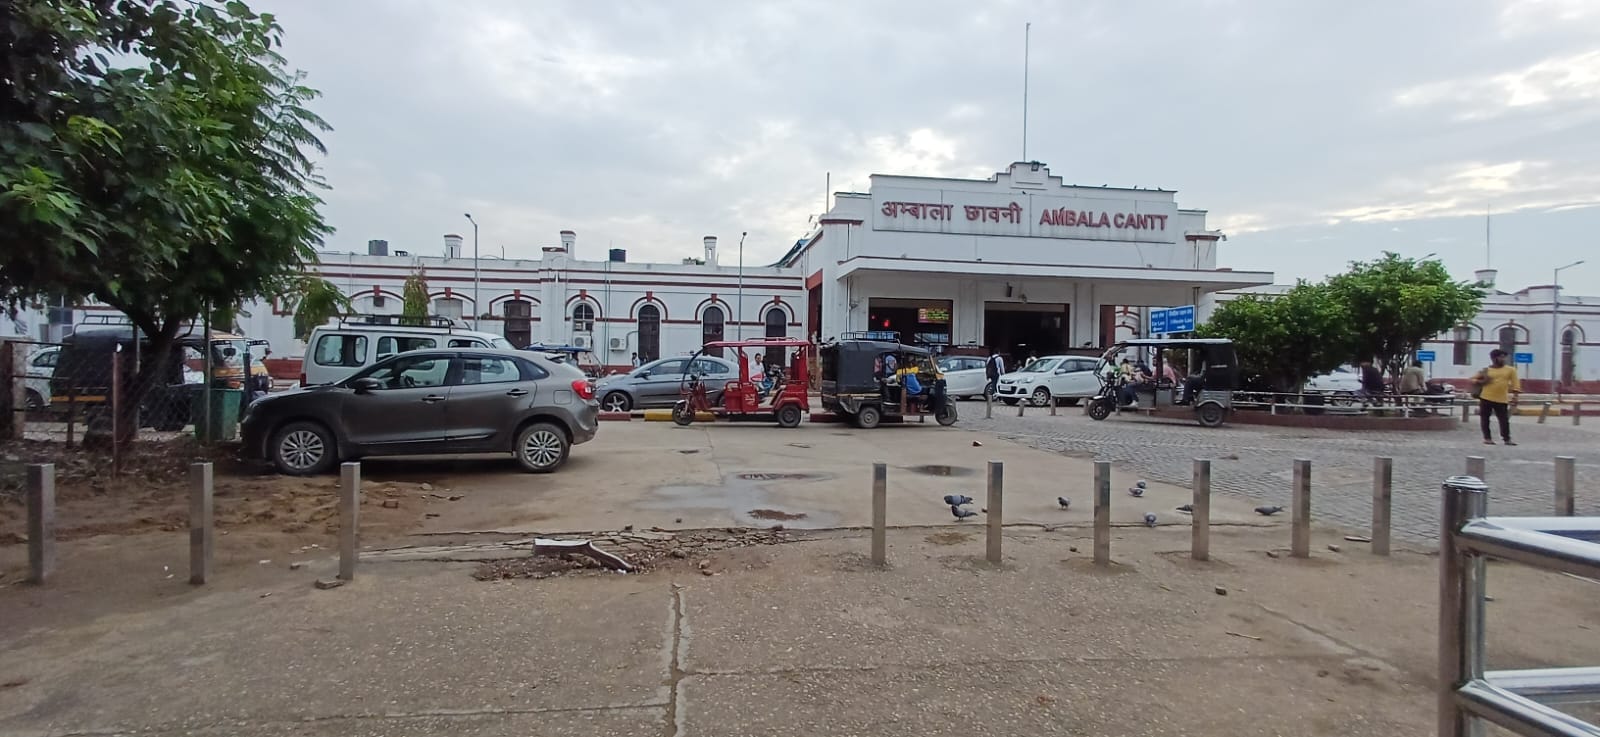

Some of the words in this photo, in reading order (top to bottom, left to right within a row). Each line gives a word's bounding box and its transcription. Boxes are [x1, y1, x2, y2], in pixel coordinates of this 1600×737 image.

[881, 201, 954, 222] अम्बाला
[963, 201, 1023, 225] छावनी
[1039, 208, 1111, 230] AMBALA
[1117, 213, 1169, 233] CANTT
